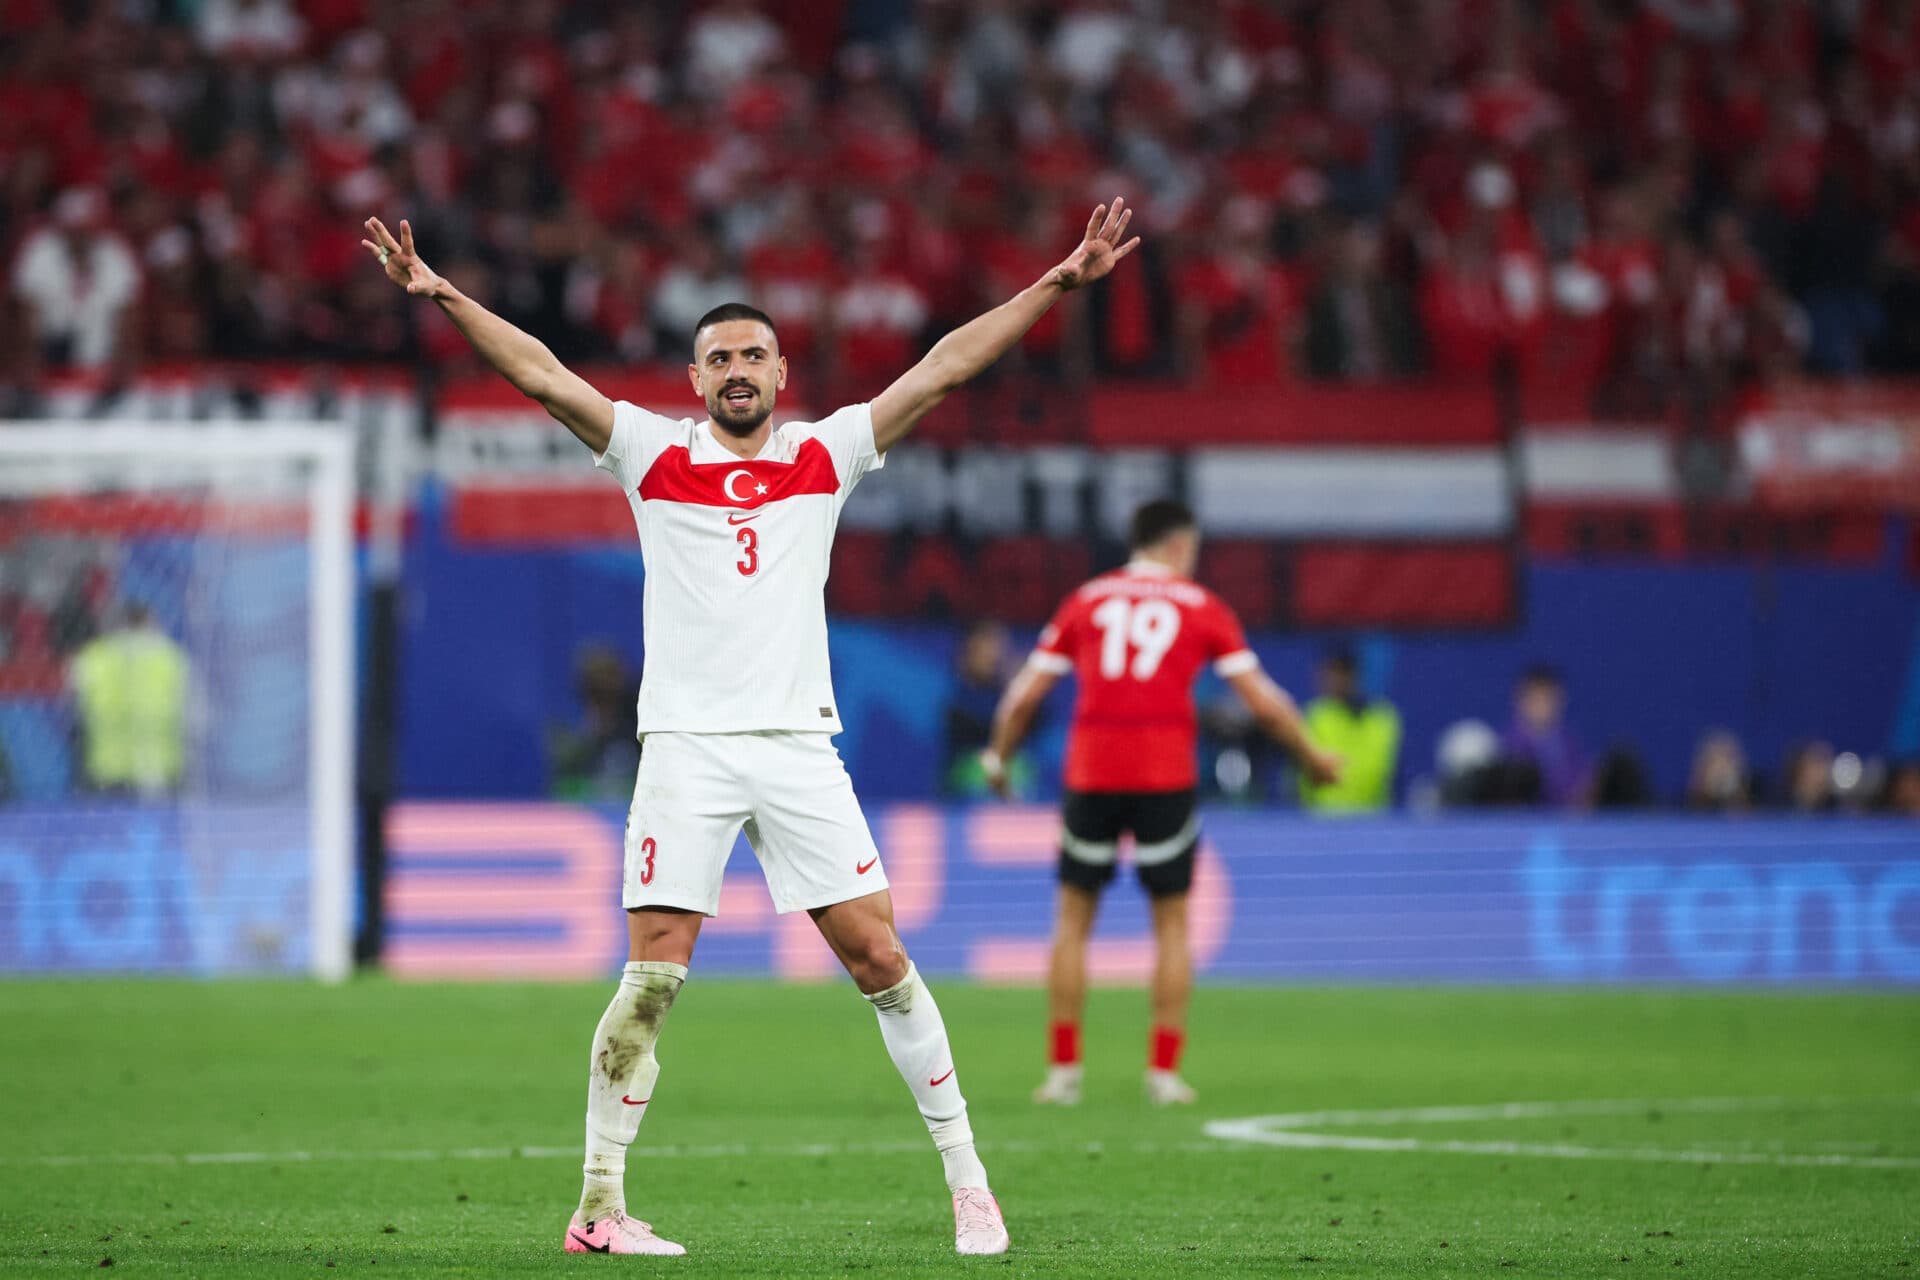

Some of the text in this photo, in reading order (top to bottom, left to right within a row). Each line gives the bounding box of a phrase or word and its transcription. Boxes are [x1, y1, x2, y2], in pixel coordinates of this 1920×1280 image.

[737, 527, 759, 577] 3
[1092, 597, 1182, 681] 19
[641, 836, 657, 887] 3
